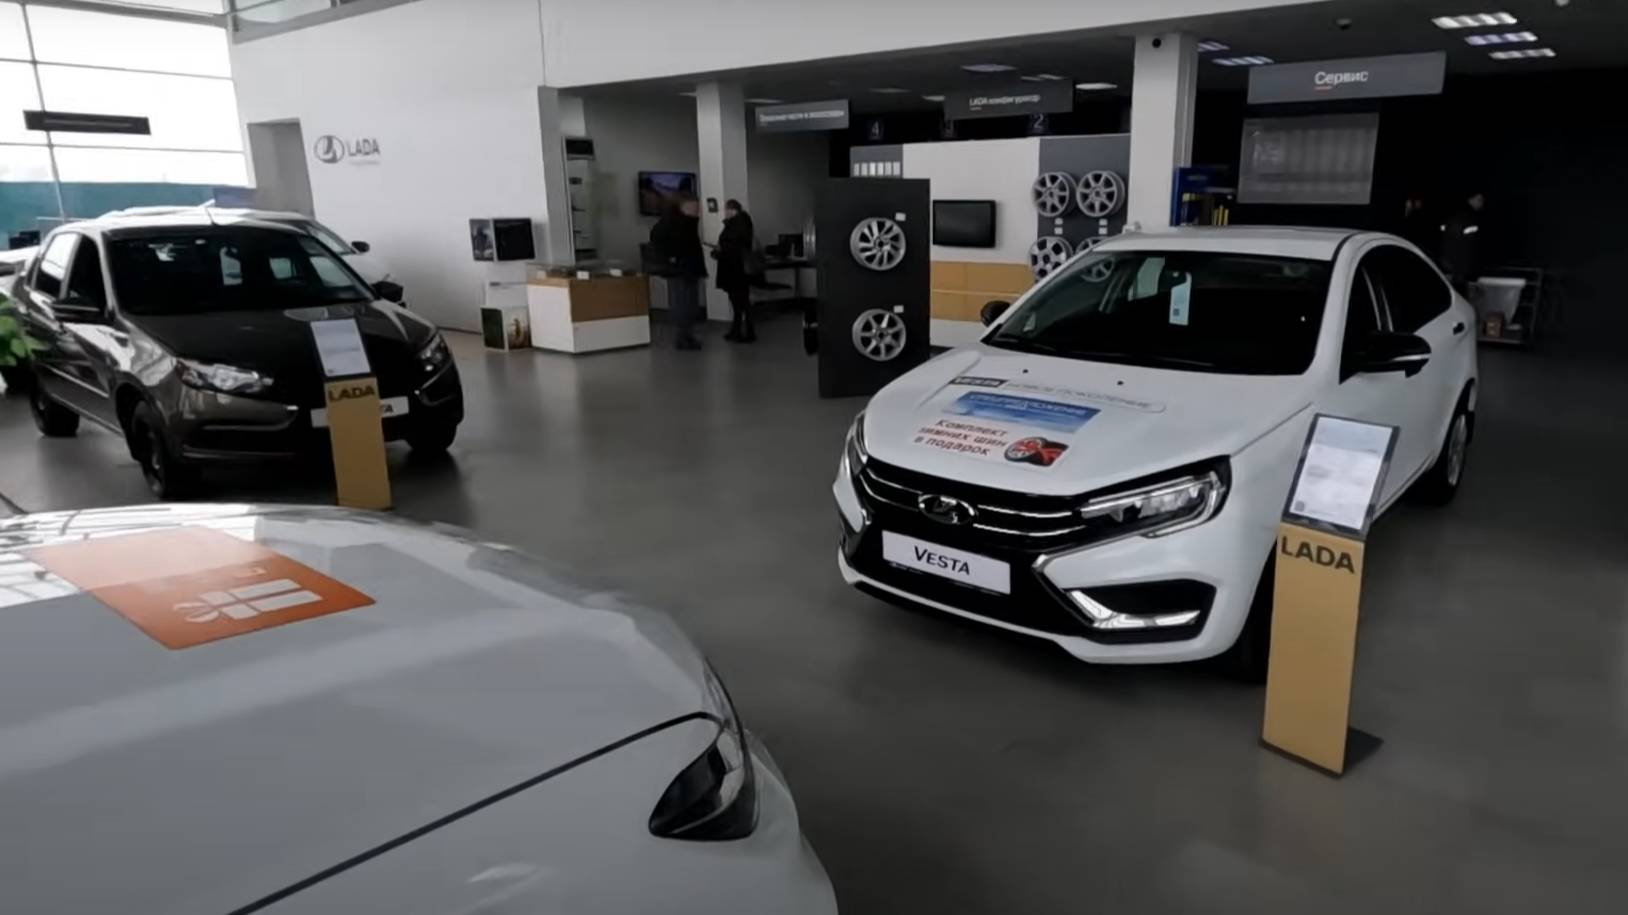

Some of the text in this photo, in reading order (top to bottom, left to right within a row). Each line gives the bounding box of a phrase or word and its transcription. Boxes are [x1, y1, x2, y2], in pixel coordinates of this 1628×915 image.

[1314, 71, 1369, 87] Сервис
[345, 138, 380, 157] LADA
[328, 385, 376, 403] LADA
[926, 438, 990, 456] подарок
[974, 435, 1007, 447] шин
[914, 545, 970, 576] VESTA
[1281, 536, 1355, 574] LADA
